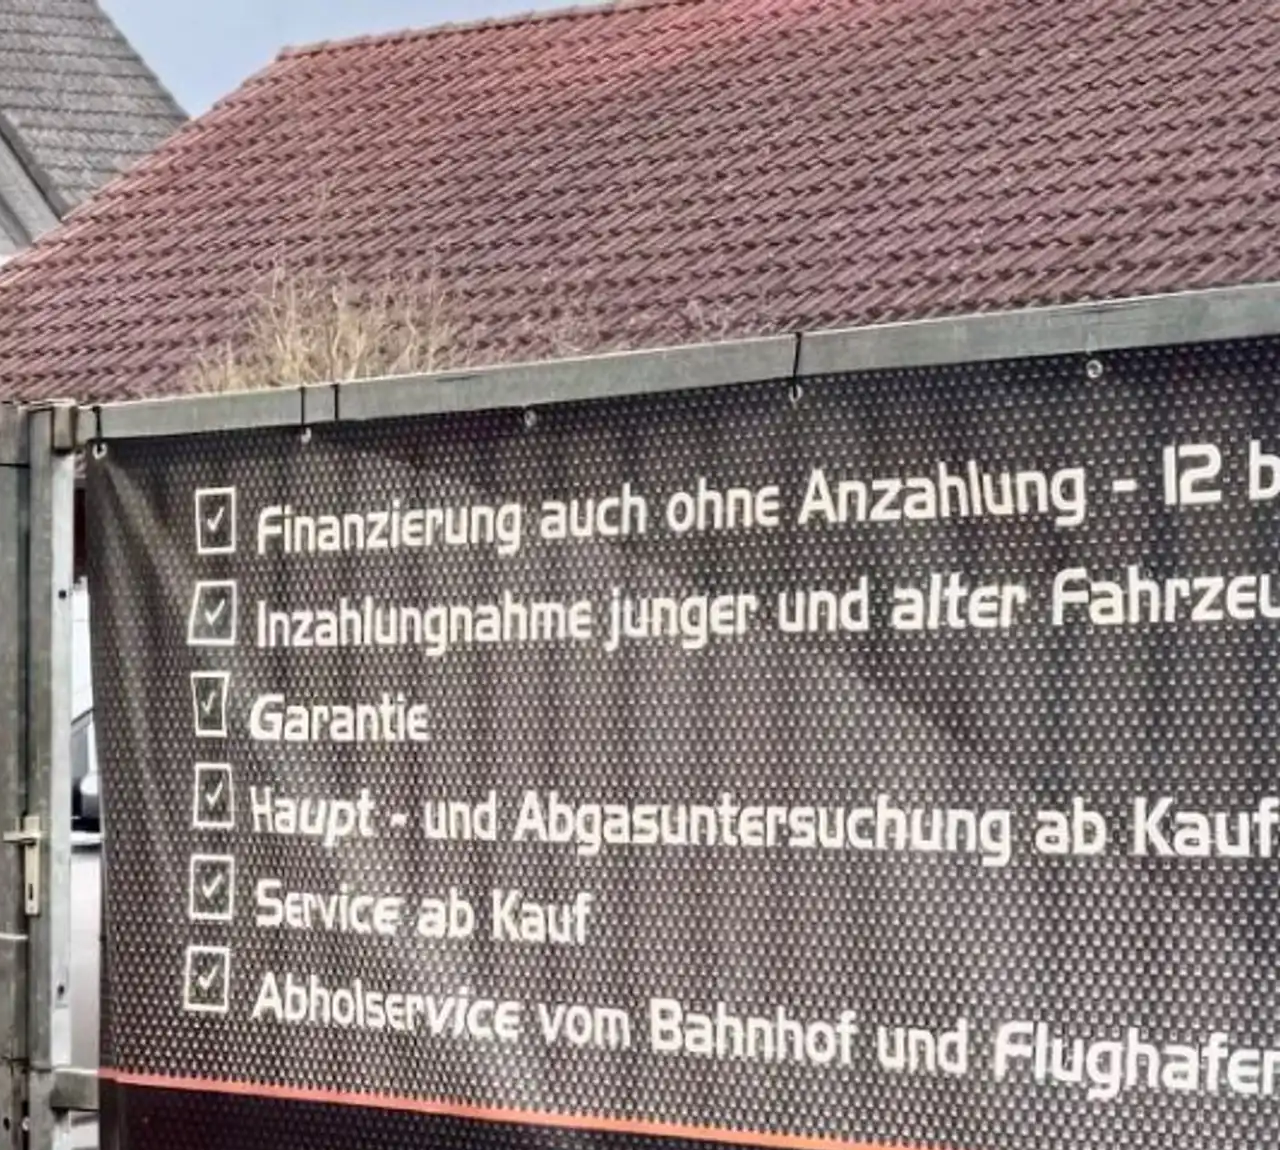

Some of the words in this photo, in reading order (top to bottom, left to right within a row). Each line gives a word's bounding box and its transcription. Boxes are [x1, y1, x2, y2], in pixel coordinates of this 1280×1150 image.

[256, 502, 522, 555] Finanzierung
[540, 484, 646, 540] auch
[666, 479, 780, 531] ohne
[798, 461, 1087, 527] Anzahlung
[1163, 443, 1222, 506] 12
[257, 590, 592, 656] Inzahlungnahme
[606, 588, 757, 651] junger
[778, 576, 869, 632] und
[892, 572, 1026, 632] alter
[248, 693, 430, 742] Garantie
[250, 786, 374, 847] Haupt
[423, 790, 497, 840] und
[513, 790, 1011, 867] Abgasuntersuchung
[1036, 798, 1106, 854] ab
[1134, 796, 1280, 857] Kauf
[255, 878, 402, 935] Service
[417, 887, 474, 937] ab
[492, 888, 592, 945] Kauf
[252, 971, 521, 1041] Abholservice
[539, 1001, 632, 1048] vom
[651, 1000, 856, 1065] Bahnhof
[877, 1018, 968, 1074] und
